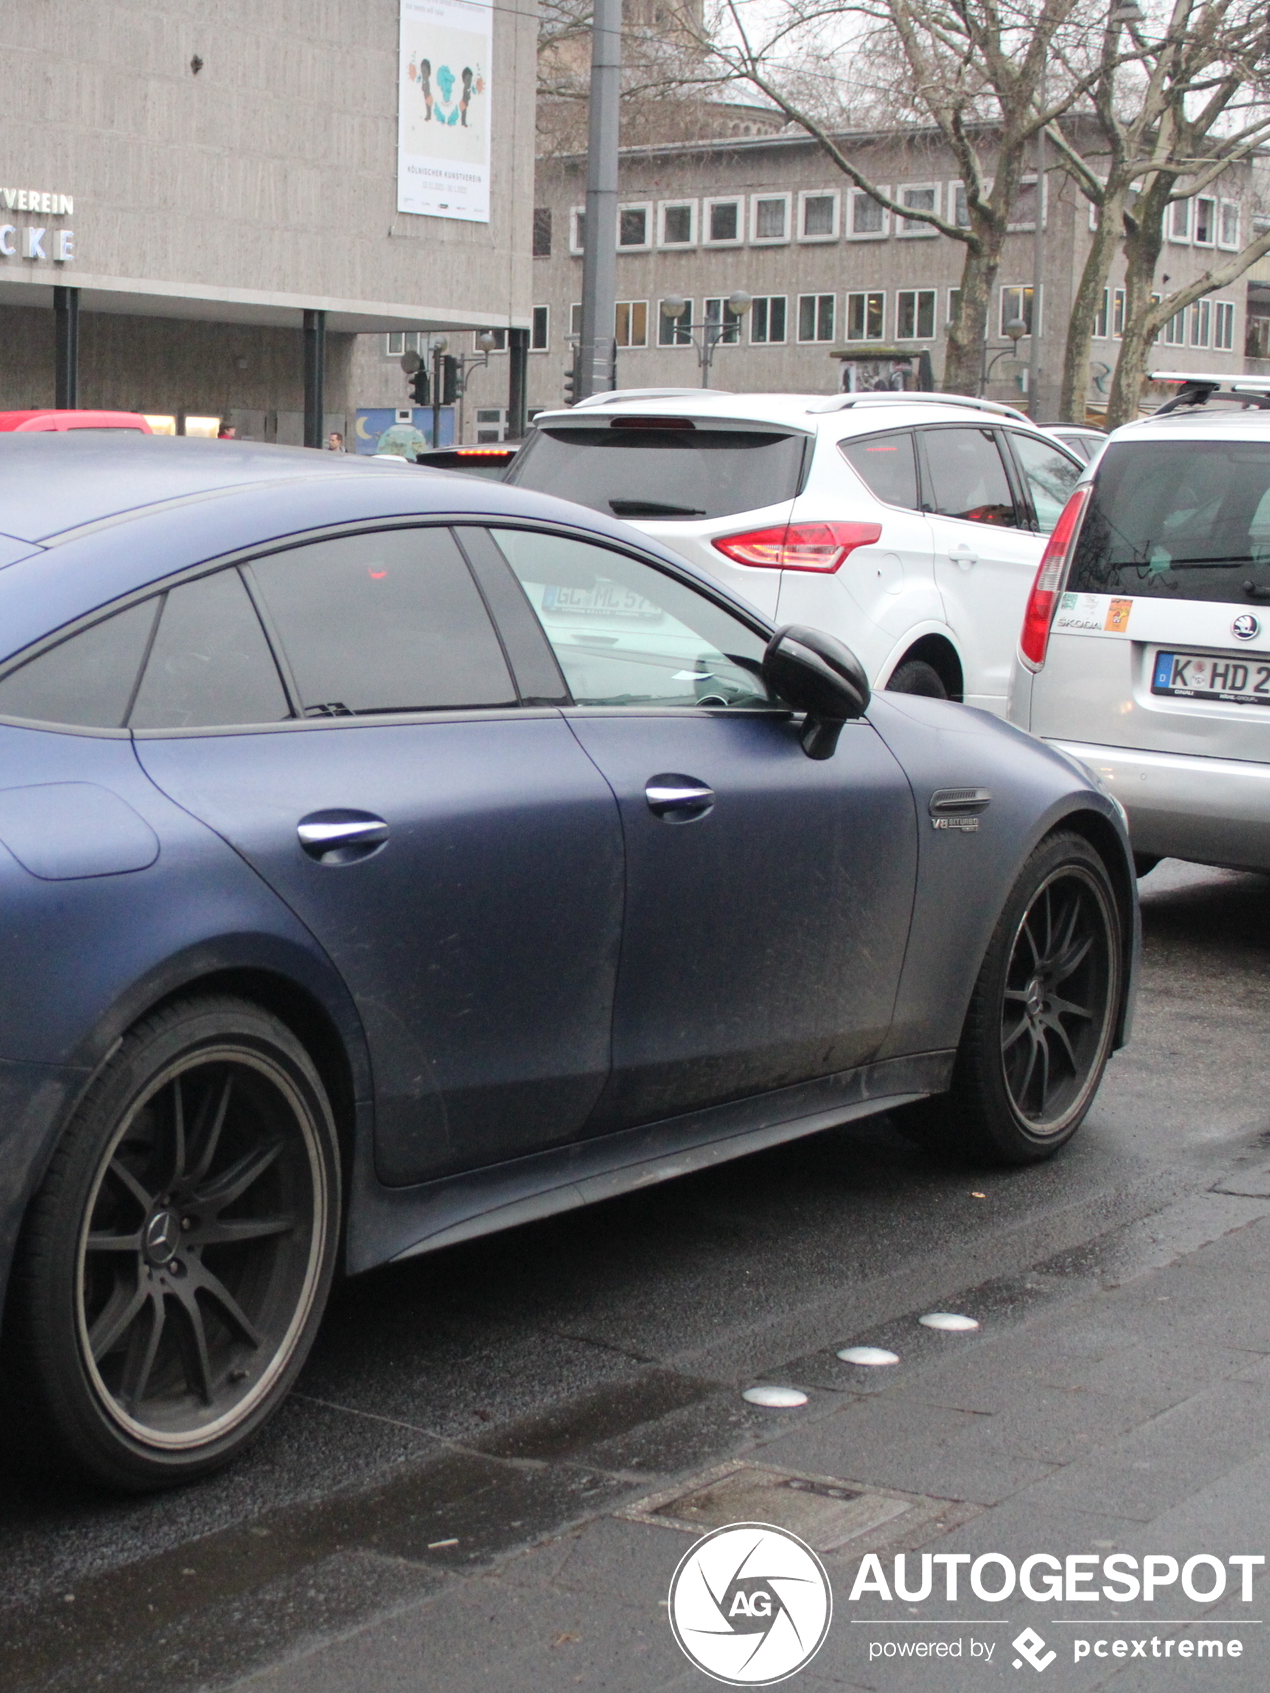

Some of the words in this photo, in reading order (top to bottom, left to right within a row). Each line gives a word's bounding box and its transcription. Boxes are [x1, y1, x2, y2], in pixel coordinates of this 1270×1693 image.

[407, 165, 442, 177] KÖLNISCHER
[444, 171, 482, 183] KUNSTVEREIN
[1057, 616, 1102, 631] ŠKODA
[1171, 658, 1192, 687] K
[1209, 662, 1248, 692] HD
[932, 818, 949, 829] V8
